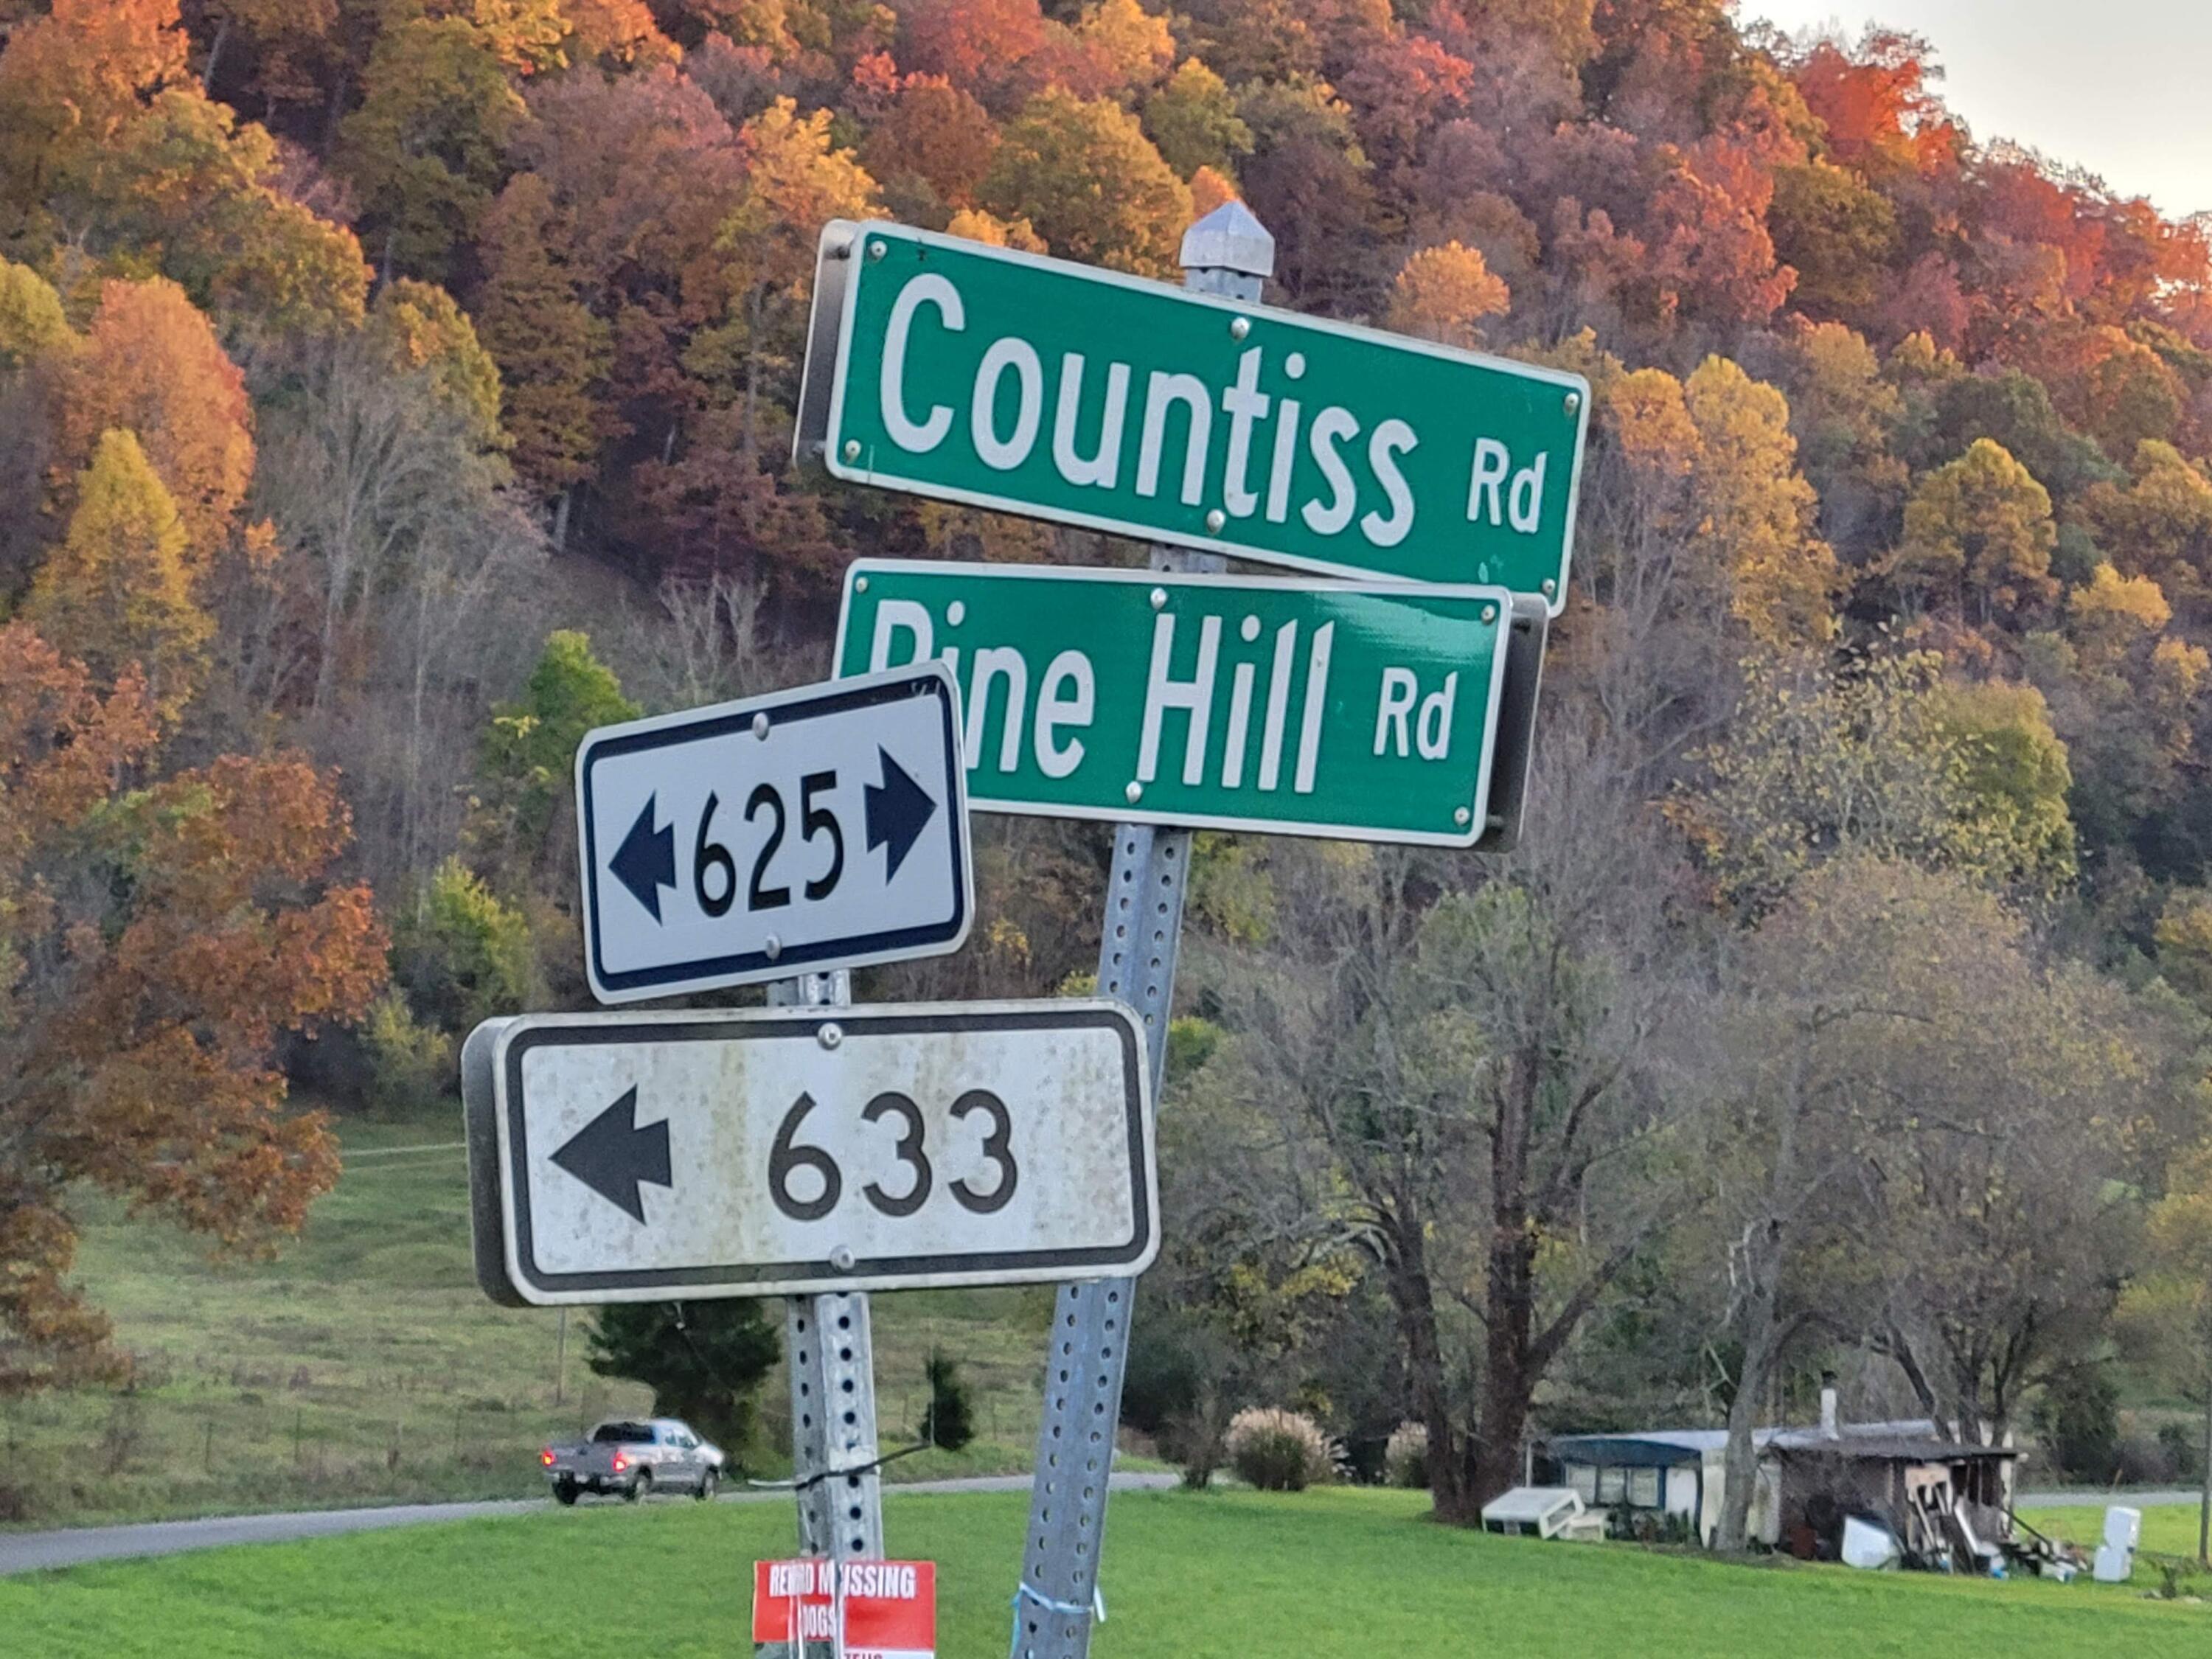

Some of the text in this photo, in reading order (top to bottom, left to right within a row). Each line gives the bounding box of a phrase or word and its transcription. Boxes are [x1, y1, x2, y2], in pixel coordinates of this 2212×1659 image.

[880, 272, 1548, 549] Countiss Rd
[1136, 613, 1335, 793] Hill
[1373, 667, 1458, 761] Rd
[694, 769, 844, 917] 625
[768, 1088, 1018, 1222] 633
